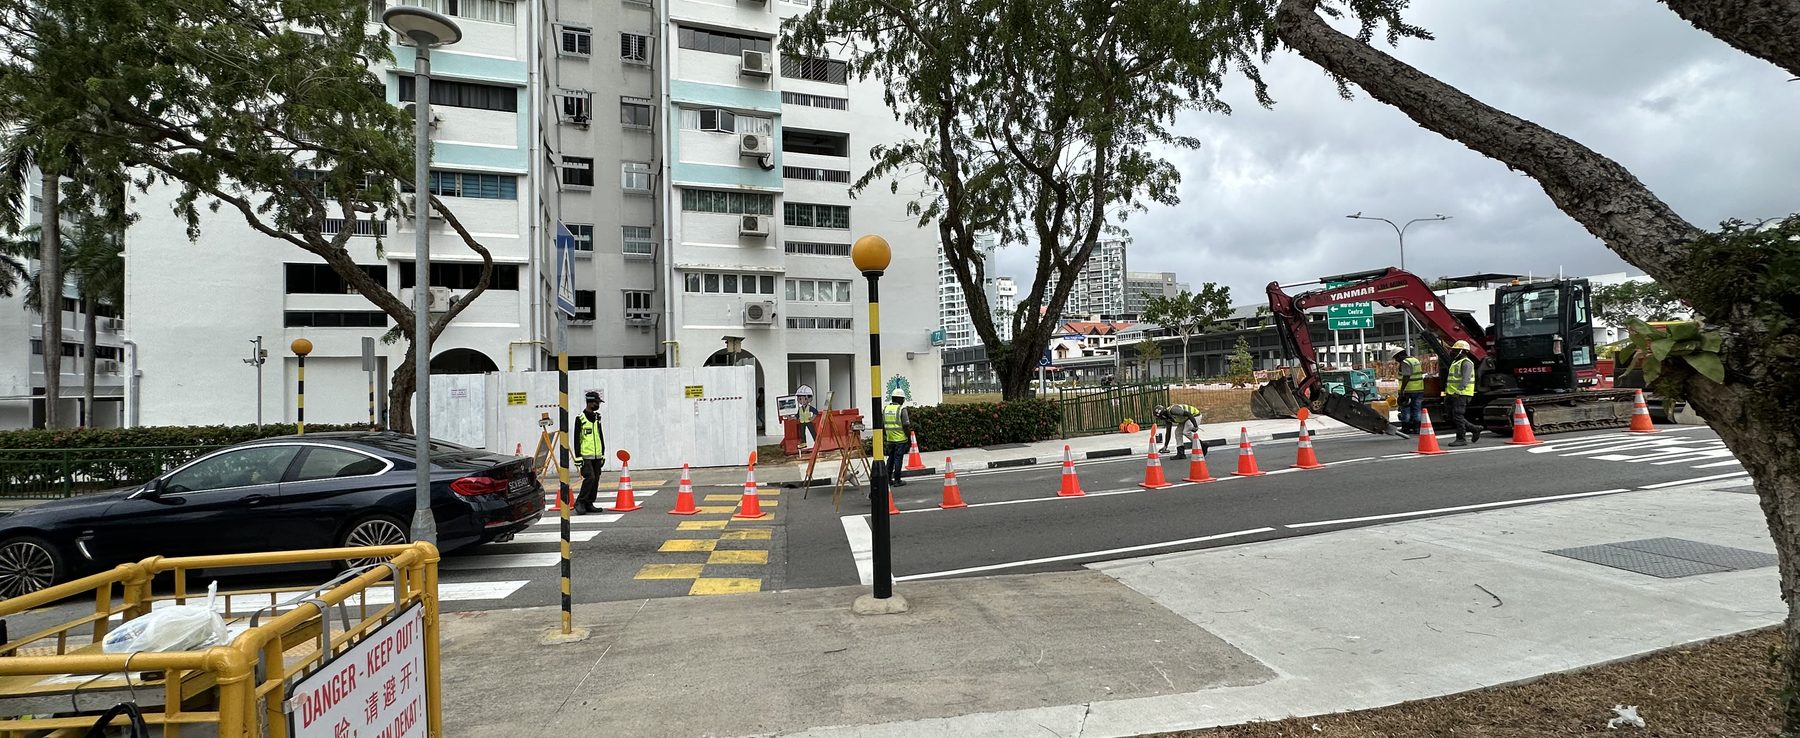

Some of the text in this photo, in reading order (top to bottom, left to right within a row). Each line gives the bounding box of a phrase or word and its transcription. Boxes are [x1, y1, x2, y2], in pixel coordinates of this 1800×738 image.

[1330, 286, 1375, 301] YANMAR
[302, 663, 356, 729] DANGER
[367, 636, 393, 678] KEEP
